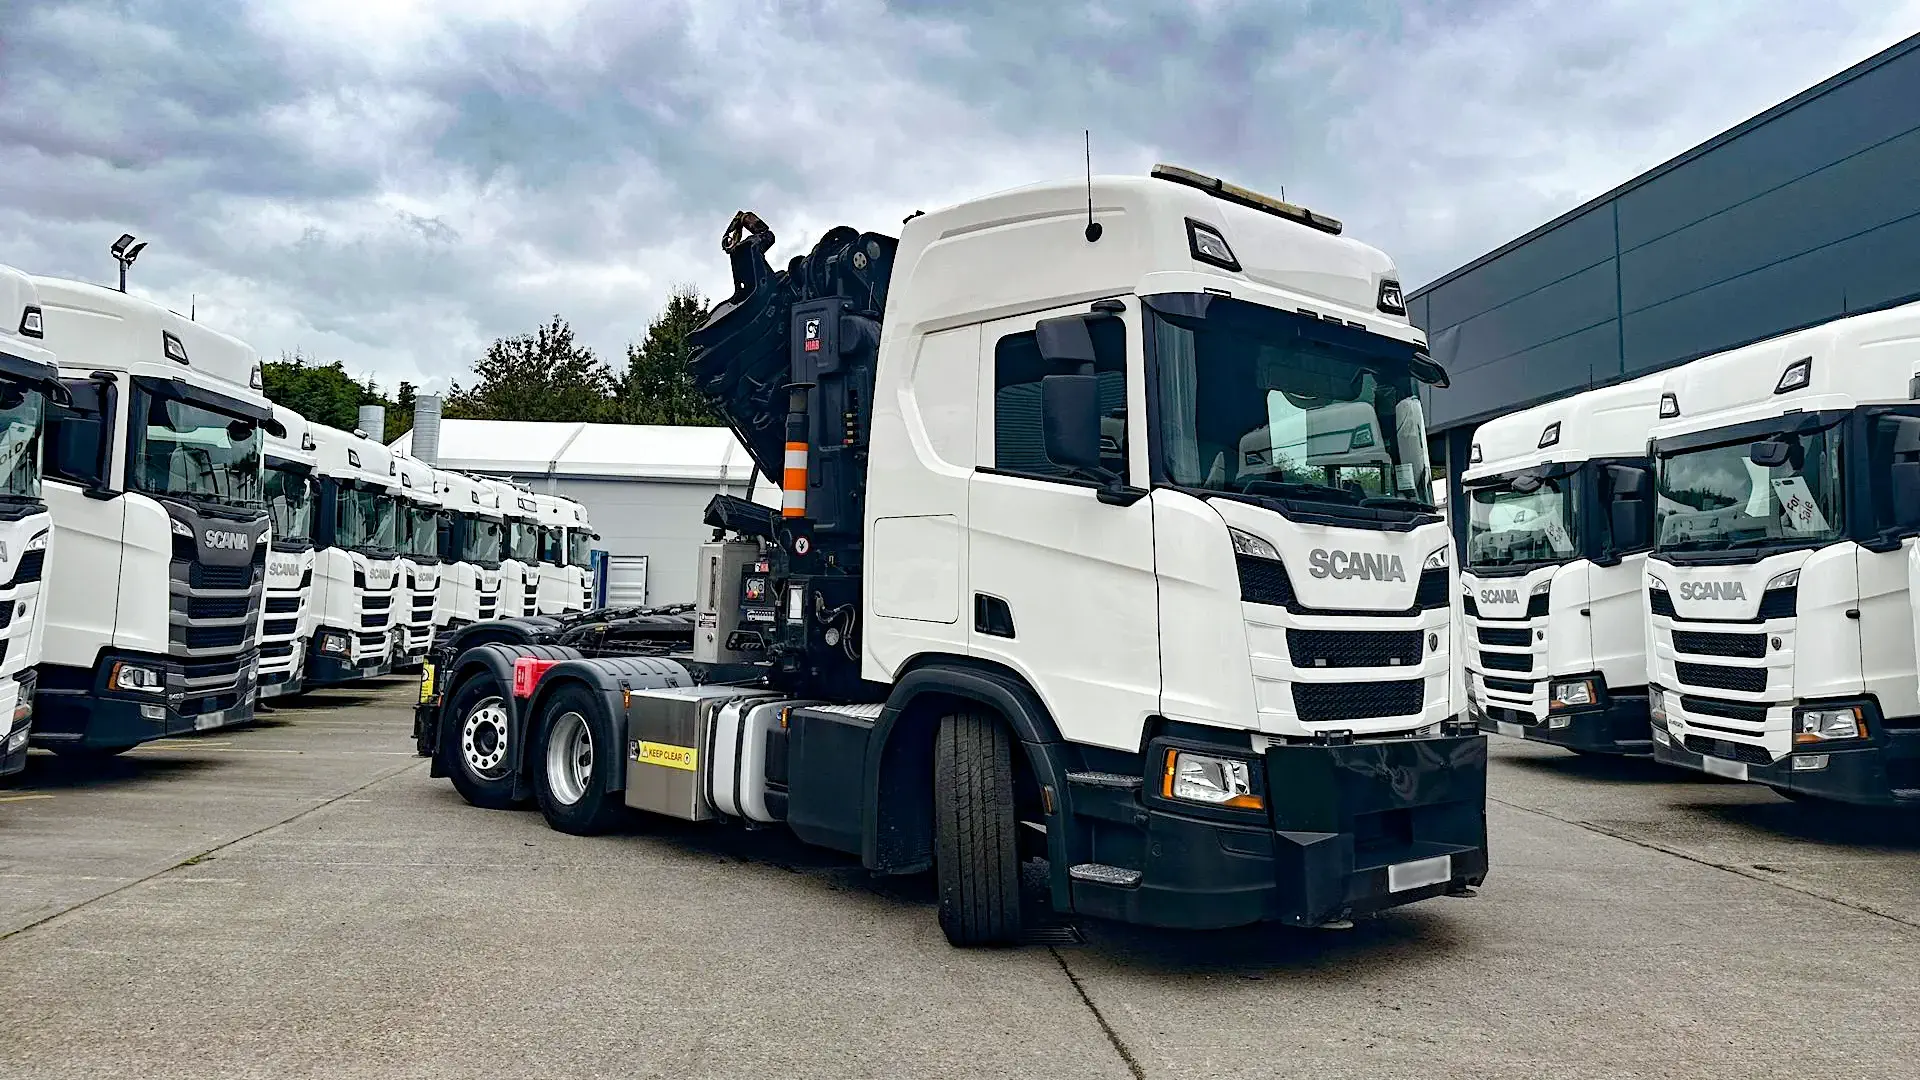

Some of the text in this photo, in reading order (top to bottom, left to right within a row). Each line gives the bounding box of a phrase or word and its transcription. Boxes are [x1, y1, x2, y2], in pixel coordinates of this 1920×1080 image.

[1787, 493, 1800, 512] For
[1799, 501, 1813, 524] Sale
[205, 530, 249, 550] SCANIA
[269, 563, 300, 576] SCANIA
[1308, 548, 1406, 582] SCANIA
[1480, 589, 1520, 604] SCANIA
[1680, 581, 1747, 601] SCANIA
[649, 748, 683, 762] KEEP CLEAR
